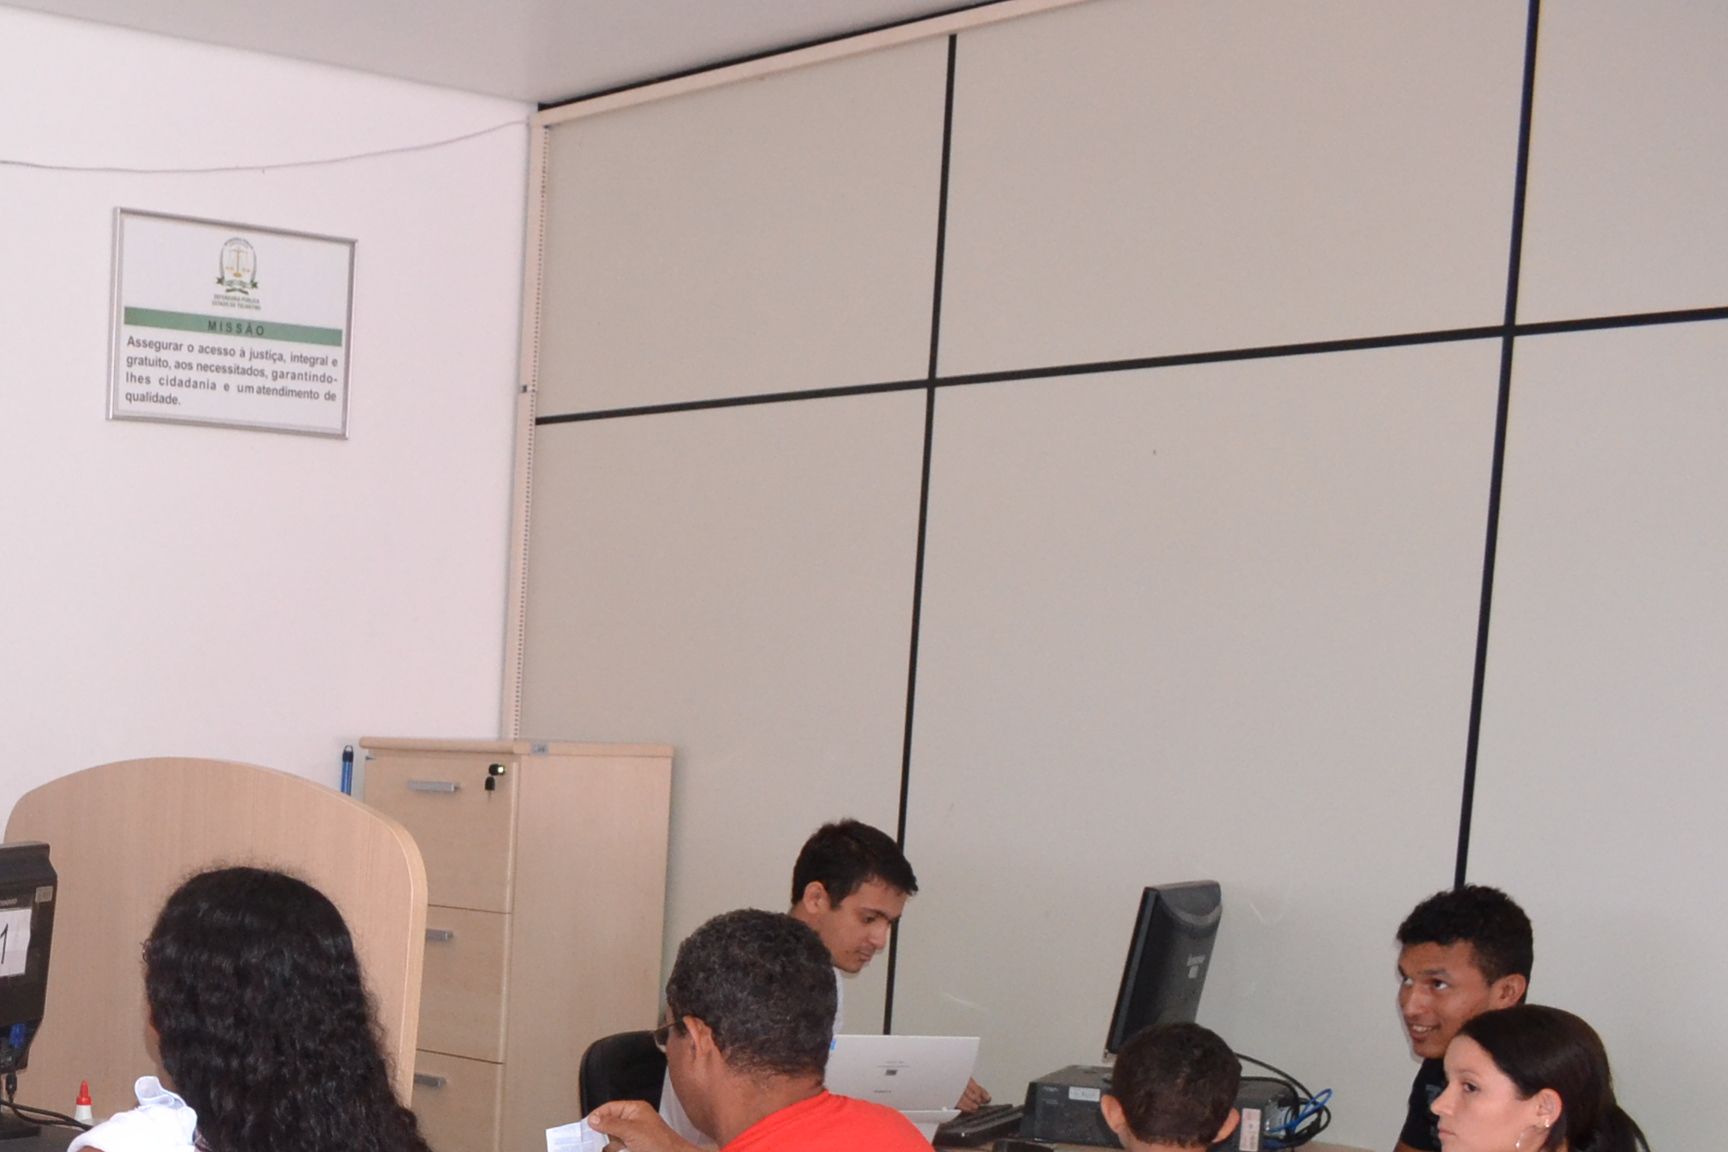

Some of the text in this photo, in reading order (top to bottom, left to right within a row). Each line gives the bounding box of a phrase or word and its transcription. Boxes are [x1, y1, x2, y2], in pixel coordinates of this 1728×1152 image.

[207, 319, 265, 336] MISSÃO
[127, 335, 338, 367] Assegurar o acesso à justiça, integral e
[126, 355, 338, 384] gratuito, aos necessitados, garantindo-
[125, 371, 337, 402] lhes cidadania e um atendimento de
[125, 391, 181, 406] qualidade.
